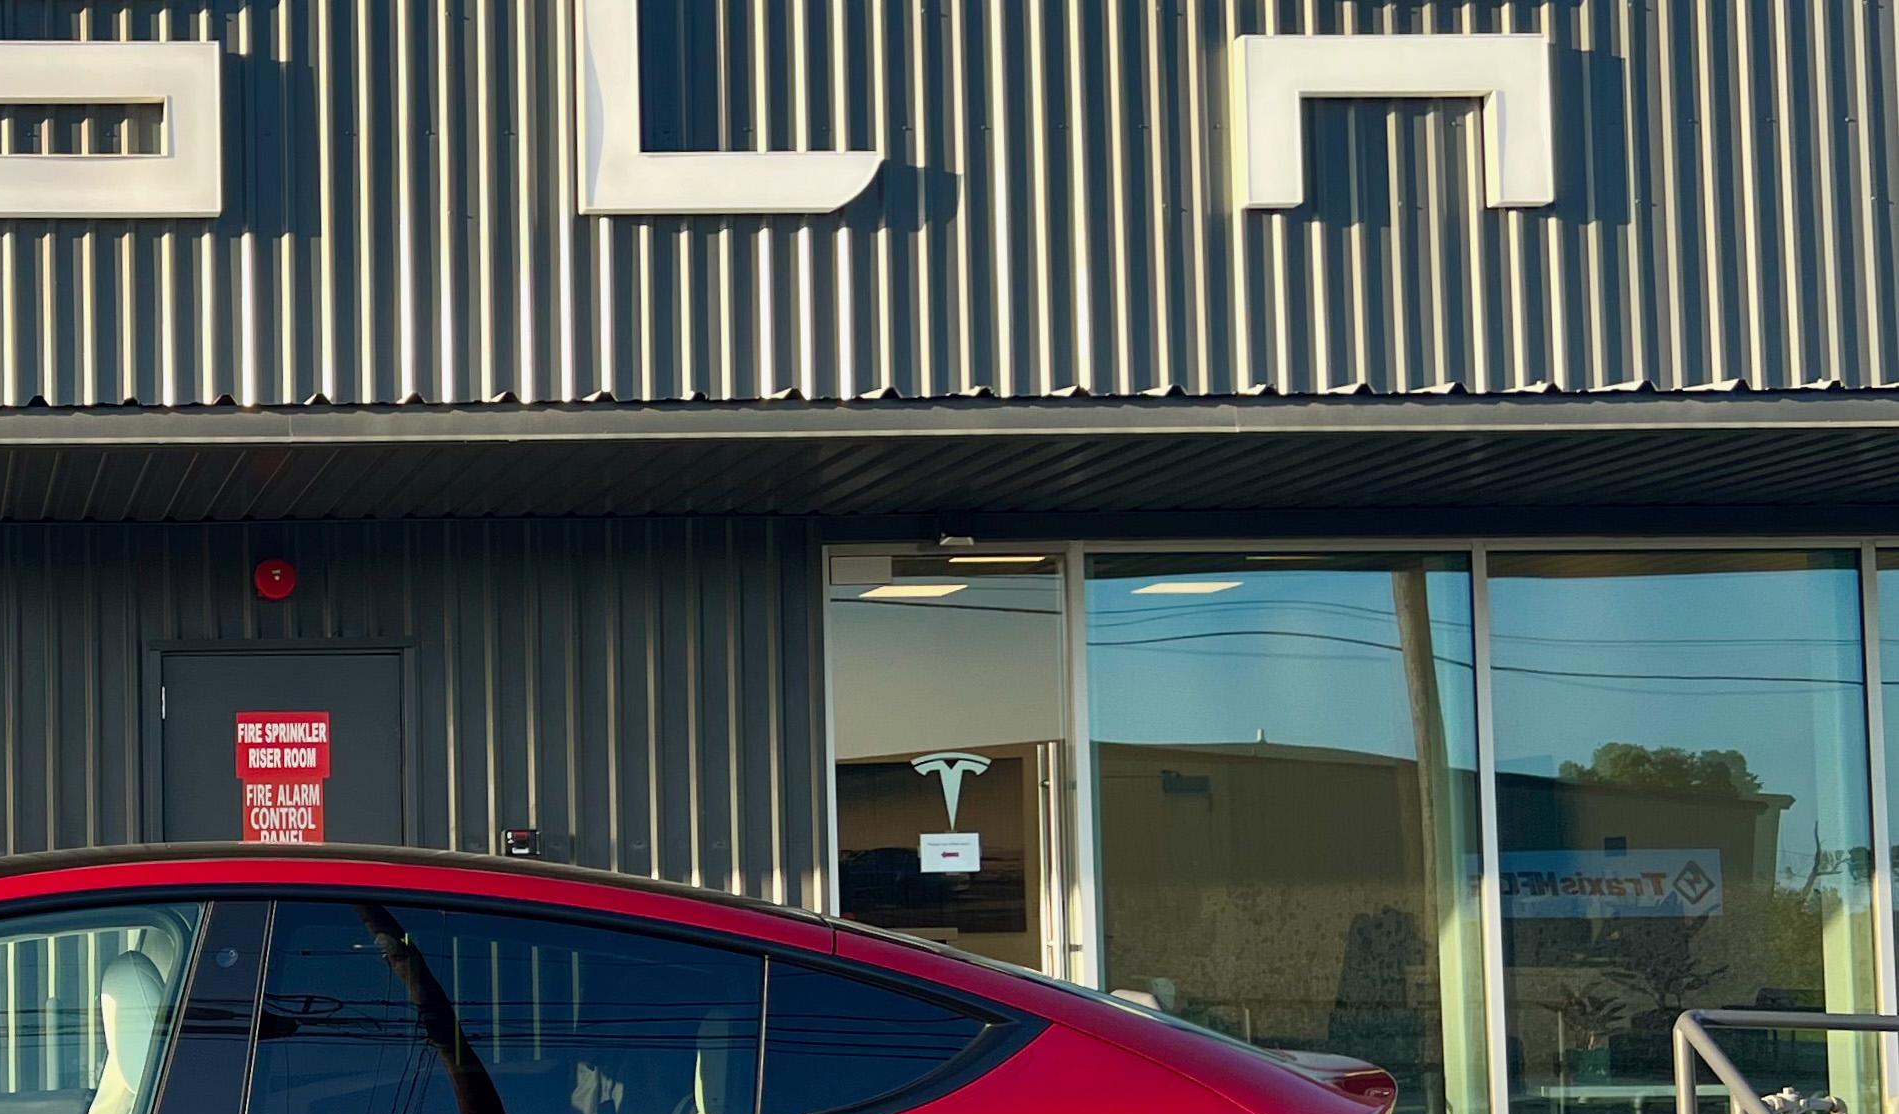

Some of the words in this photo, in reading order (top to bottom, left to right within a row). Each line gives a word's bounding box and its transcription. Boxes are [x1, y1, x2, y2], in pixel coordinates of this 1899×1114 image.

[238, 723, 262, 743] FIRE
[265, 723, 327, 743] SPRINKLER
[248, 748, 281, 768] RISER
[284, 748, 316, 768] ROOM
[246, 784, 272, 806] FIRE
[277, 784, 320, 806] ALARM
[250, 807, 316, 830] CONTROL
